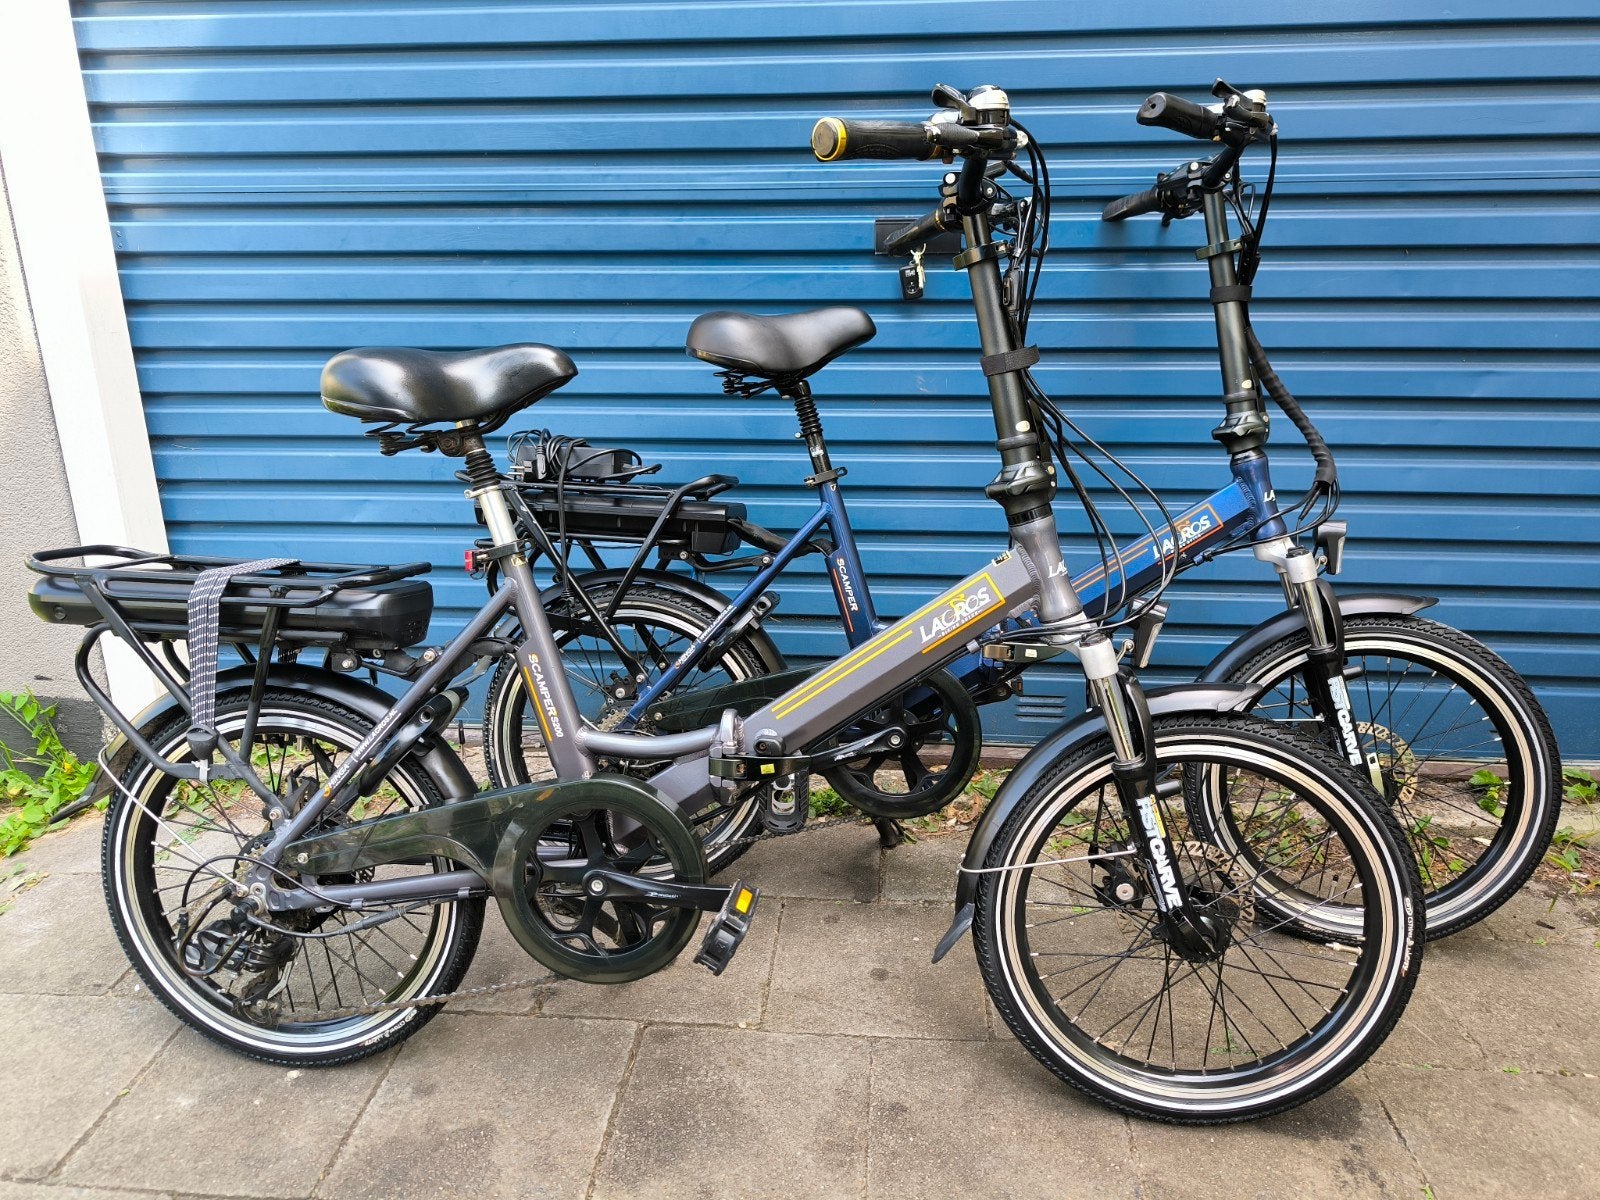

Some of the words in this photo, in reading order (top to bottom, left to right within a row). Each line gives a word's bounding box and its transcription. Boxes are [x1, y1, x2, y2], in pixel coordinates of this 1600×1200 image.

[836, 558, 859, 612] SCAMPER
[920, 586, 992, 644] LACROS
[528, 653, 559, 717] SCAMPER
[354, 708, 399, 757] WWW.LACROS.NL
